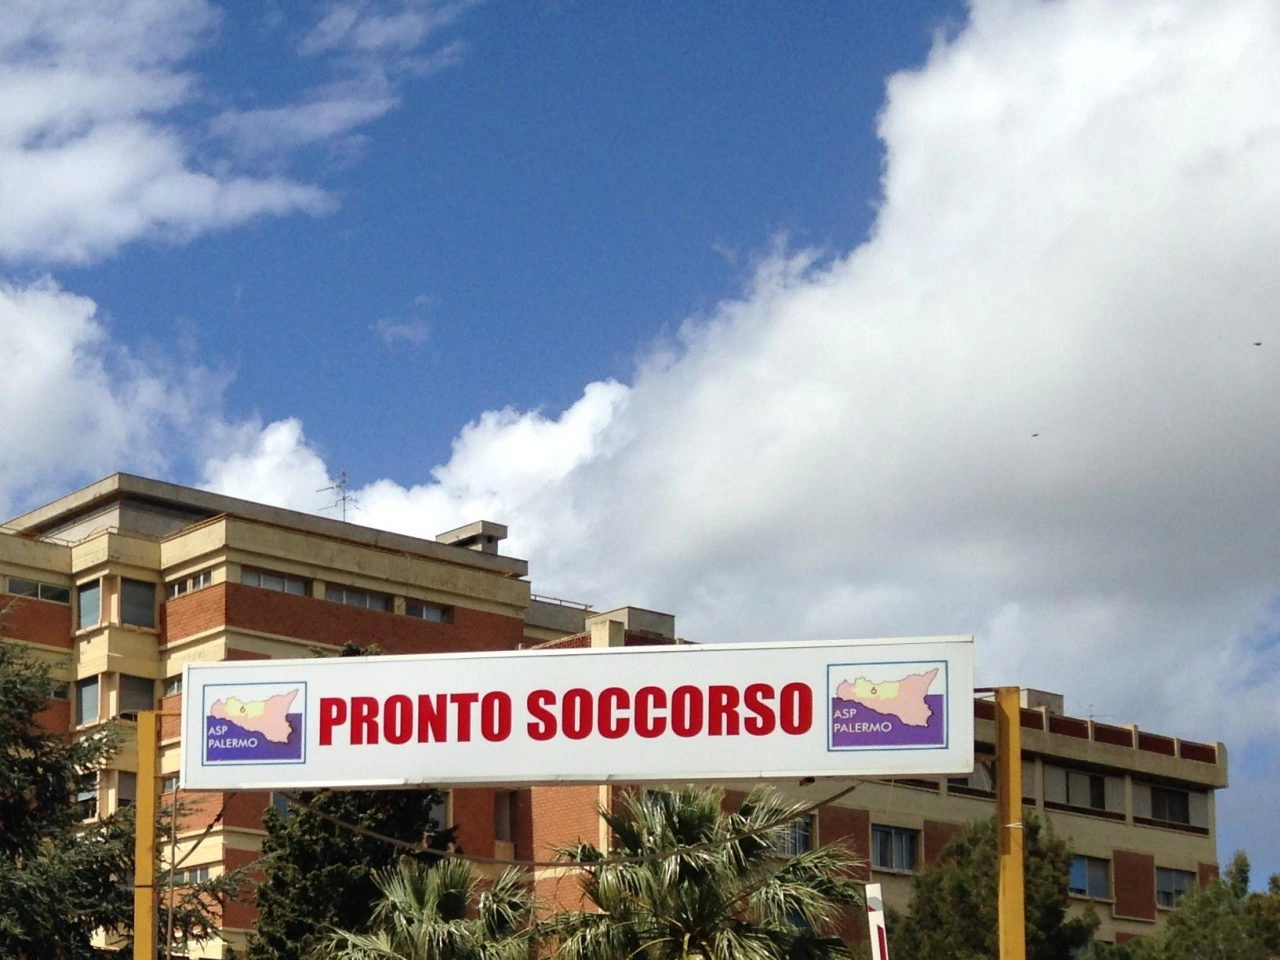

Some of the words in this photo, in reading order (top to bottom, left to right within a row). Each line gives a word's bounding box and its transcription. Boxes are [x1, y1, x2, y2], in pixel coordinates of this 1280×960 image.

[319, 690, 512, 747] PRONTO
[526, 681, 813, 742] SOCCORSO
[833, 708, 857, 719] ASP
[208, 725, 228, 736] ASP
[833, 721, 892, 733] PALERMO
[208, 737, 258, 748] PALERMO
